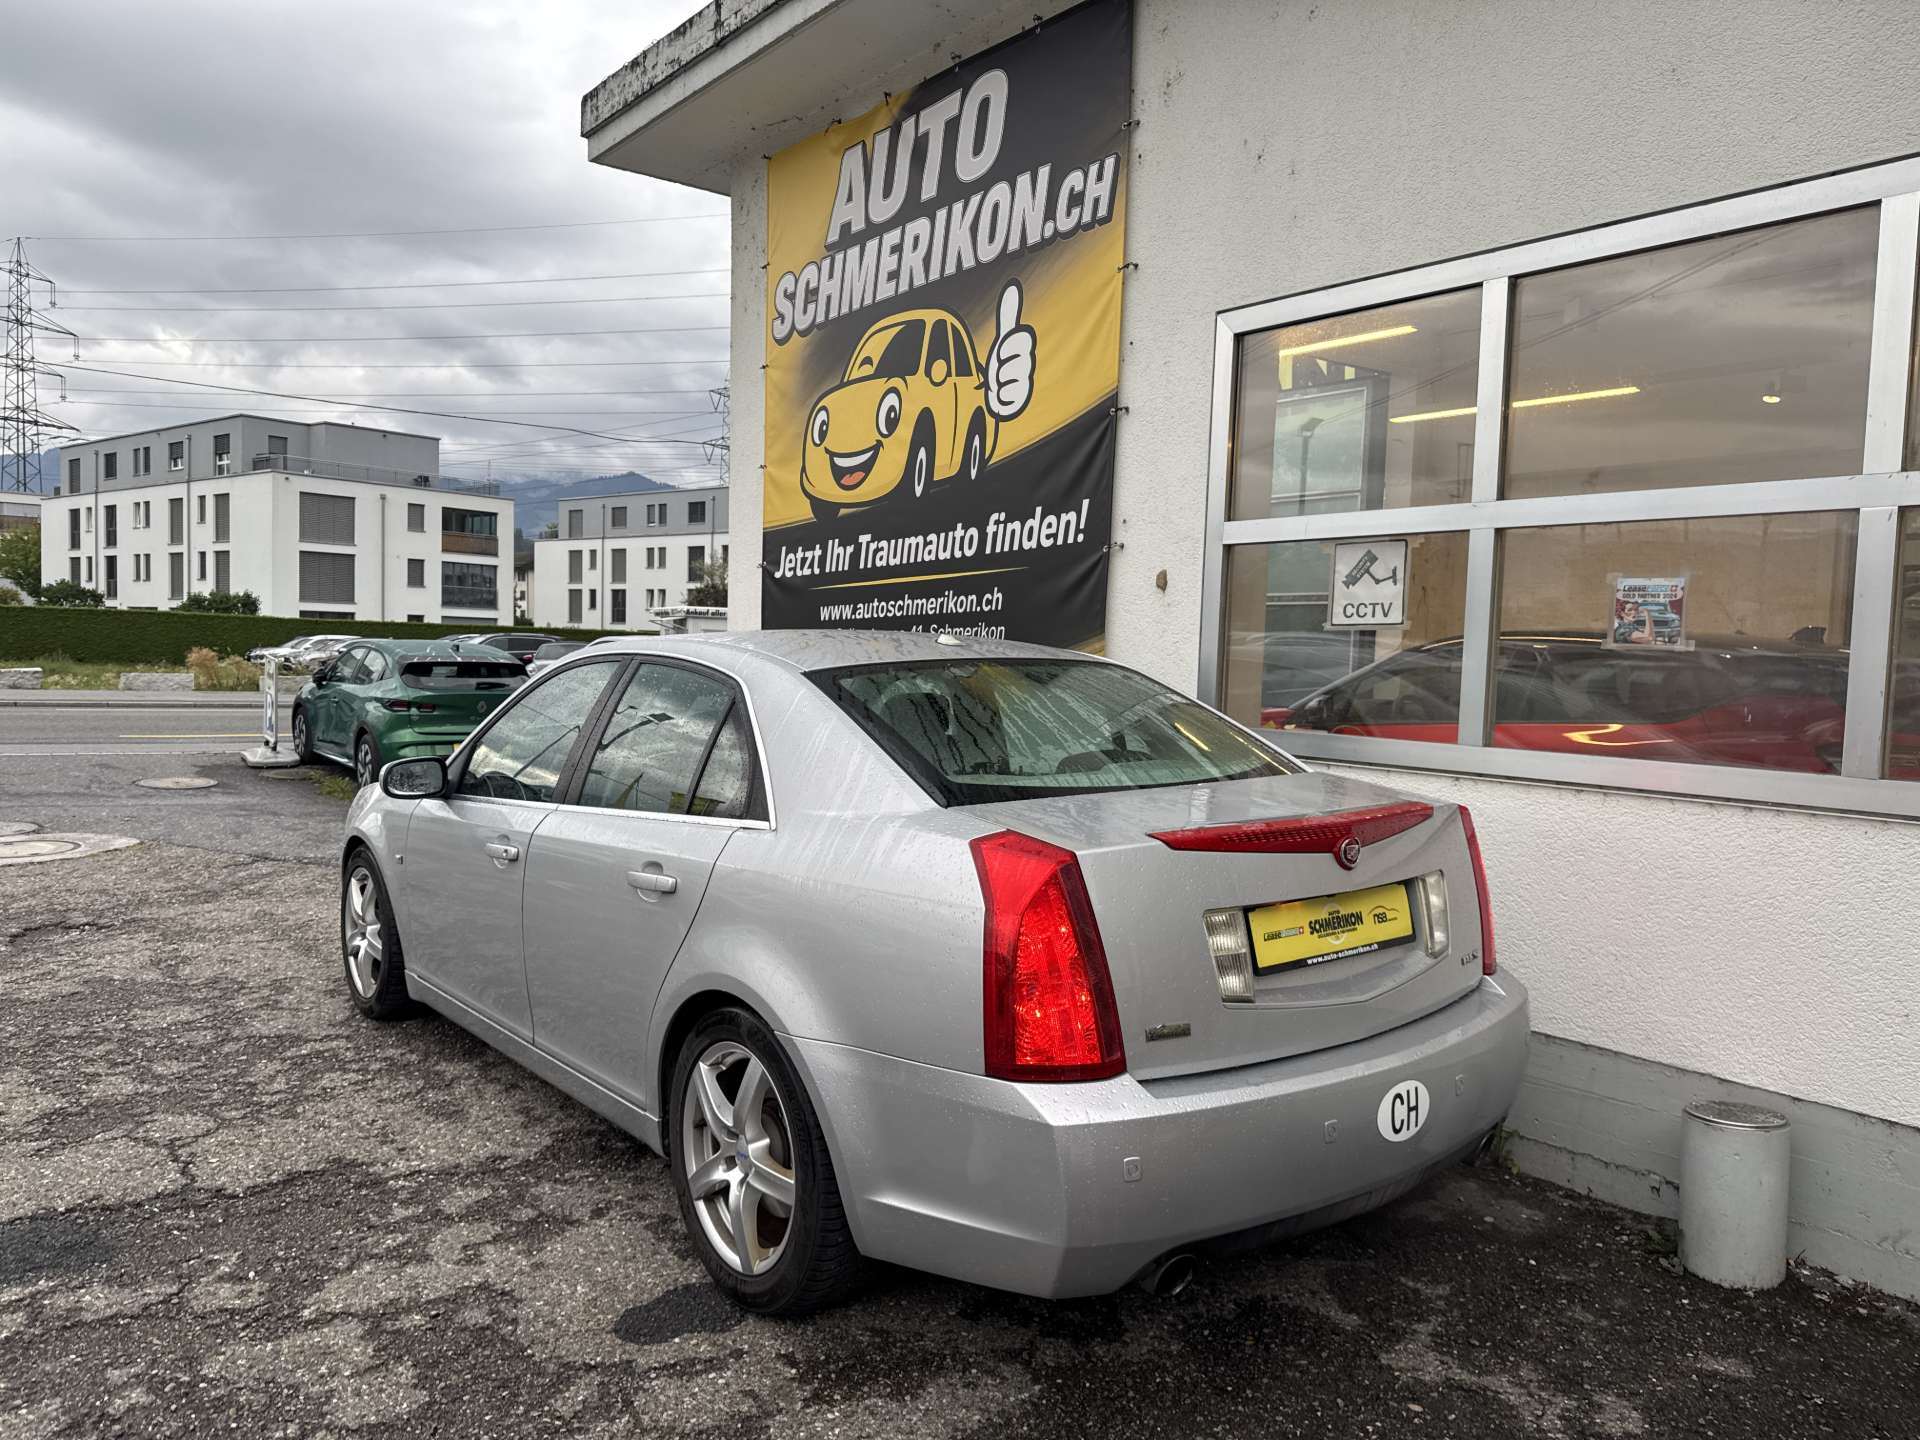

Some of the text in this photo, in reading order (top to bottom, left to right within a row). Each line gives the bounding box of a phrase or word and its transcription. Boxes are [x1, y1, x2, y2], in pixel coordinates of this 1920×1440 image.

[825, 68, 1009, 246] AUTO
[773, 154, 1118, 341] SCHMERIKON.CH
[774, 499, 1090, 579] Jetzt Ihr Traumauto finden!
[819, 587, 1003, 621] www.autoschmerikon.ch
[1343, 602, 1393, 618] CCTV
[1308, 911, 1364, 936] SCHMERIKON
[1391, 1087, 1418, 1134] CH
